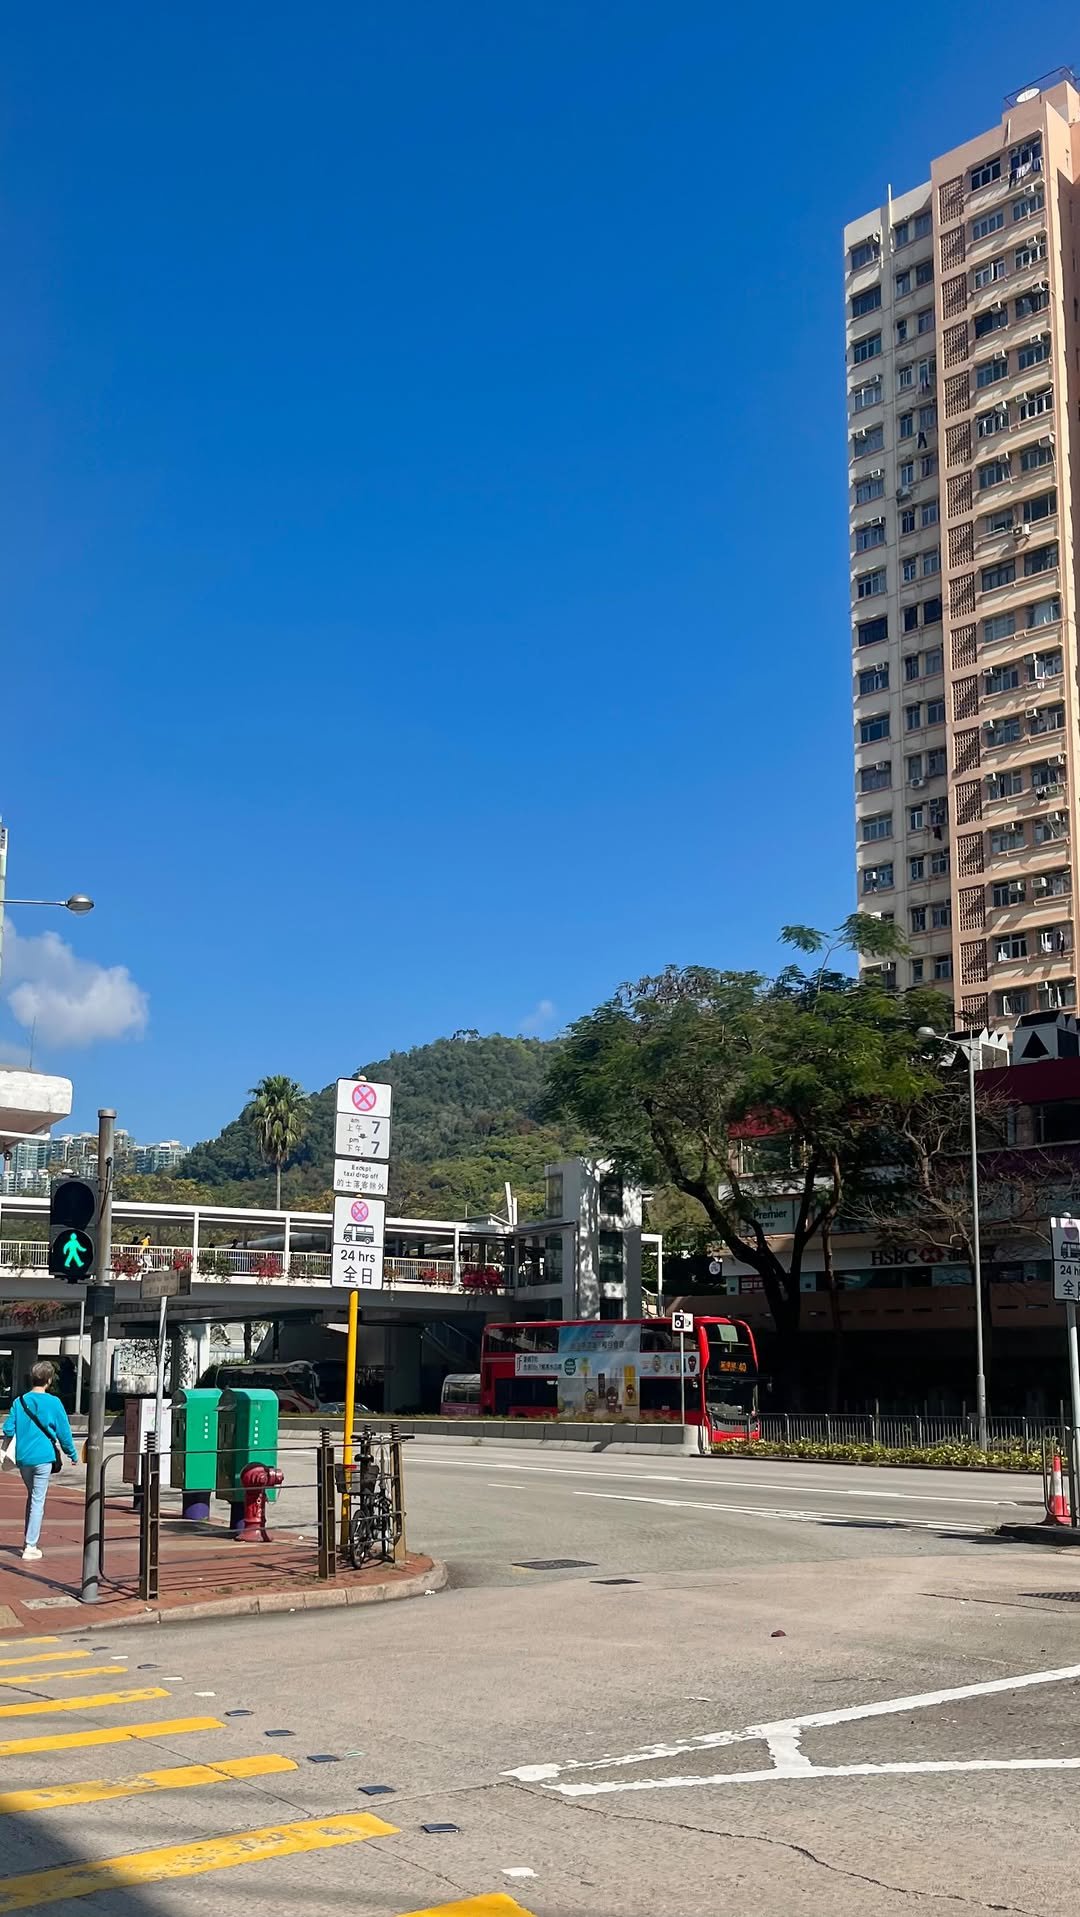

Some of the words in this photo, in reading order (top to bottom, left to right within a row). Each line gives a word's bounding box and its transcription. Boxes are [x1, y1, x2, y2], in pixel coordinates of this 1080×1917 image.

[346, 1124, 362, 1133] 上午
[371, 1120, 380, 1134] 7
[346, 1144, 361, 1153] 下午
[371, 1141, 380, 1154] 7
[753, 1208, 788, 1220] Premier
[340, 1249, 355, 1261] 24
[358, 1250, 376, 1263] hrs
[870, 1249, 918, 1267] HSBC
[343, 1265, 372, 1285] 全日
[1060, 1264, 1072, 1275] 24
